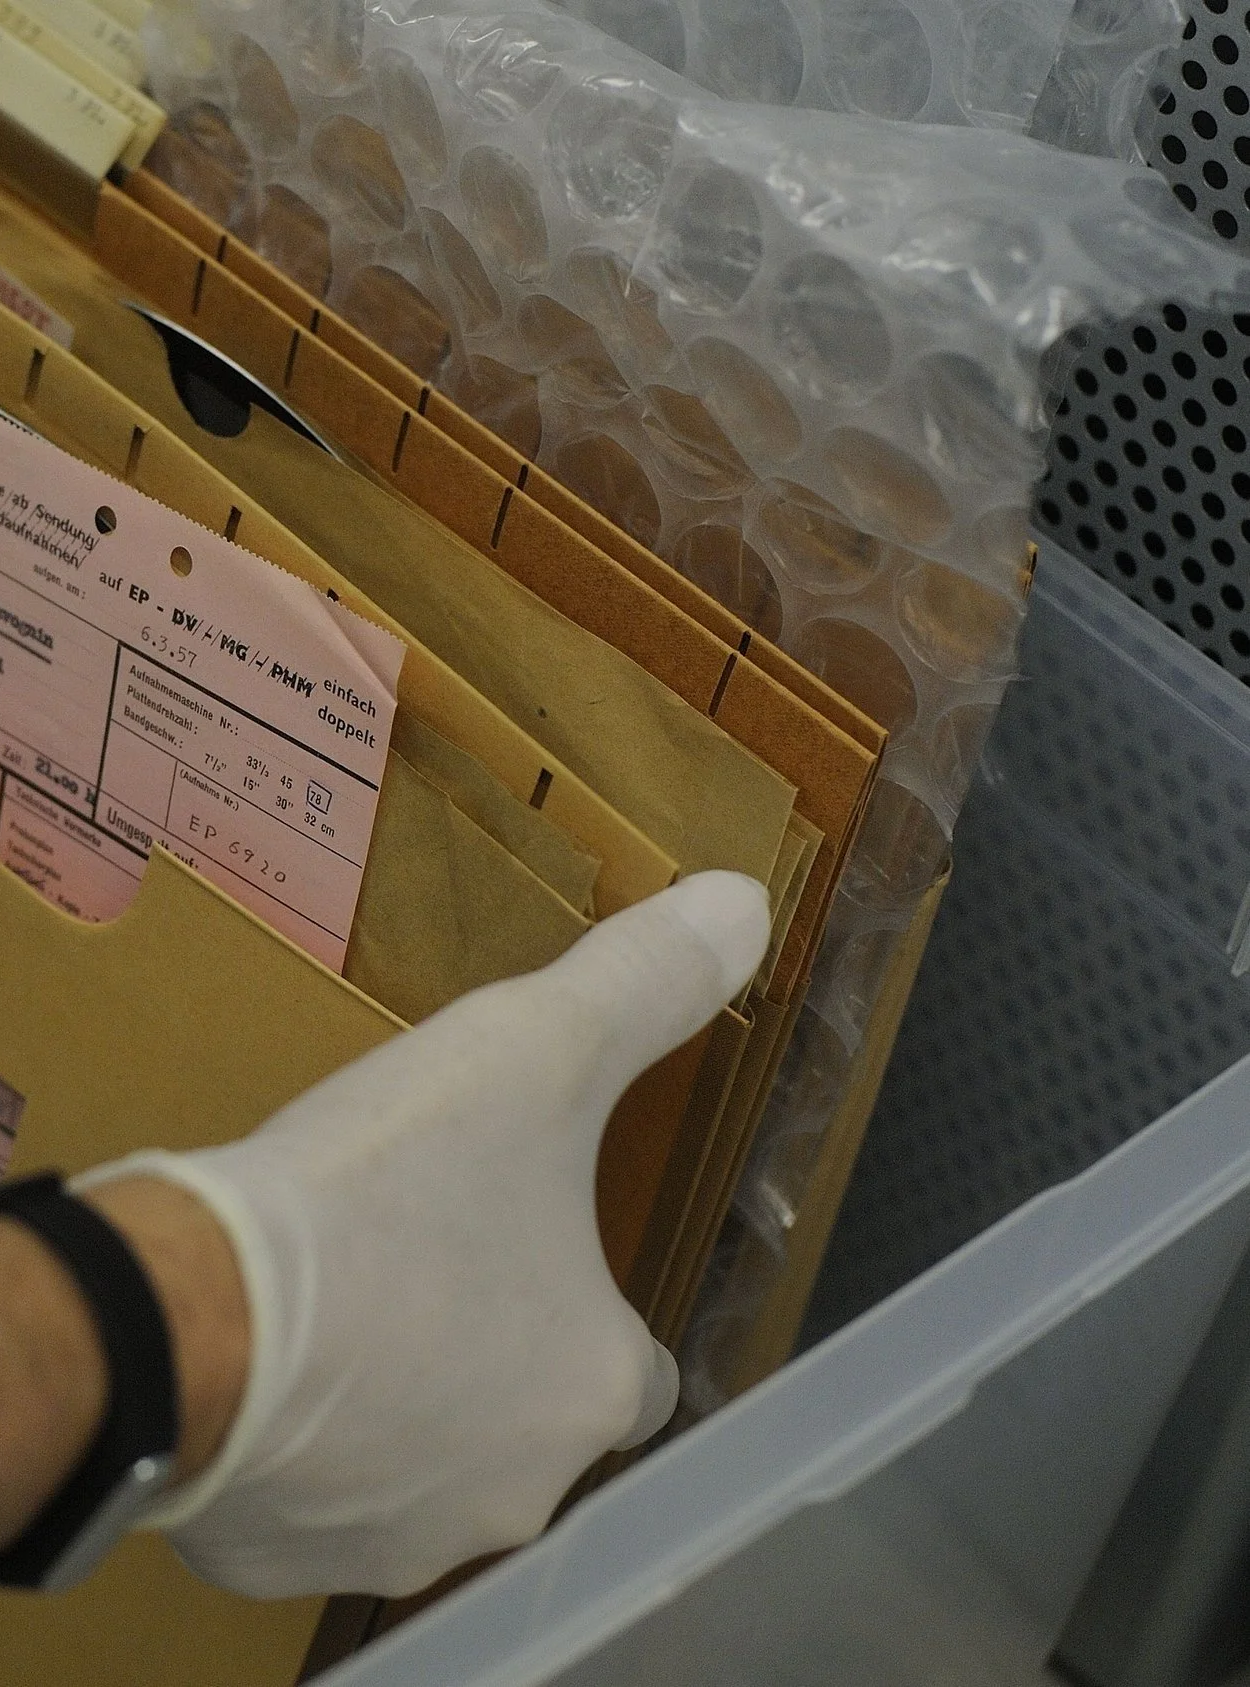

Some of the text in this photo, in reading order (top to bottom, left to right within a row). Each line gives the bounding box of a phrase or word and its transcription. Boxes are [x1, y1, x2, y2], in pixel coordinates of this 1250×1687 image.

[35, 503, 96, 551] Sendung
[99, 570, 123, 592] auf
[129, 583, 150, 605] EP
[220, 634, 249, 662] MG
[323, 678, 377, 719] einfach
[140, 626, 198, 668] 6.3.57
[129, 664, 214, 722] Aufnahmemaschine
[317, 706, 376, 749] doppelt
[280, 774, 293, 790] 45
[310, 790, 322, 806] 78
[188, 814, 217, 839] EP
[304, 812, 317, 828] 32
[320, 824, 335, 839] cm
